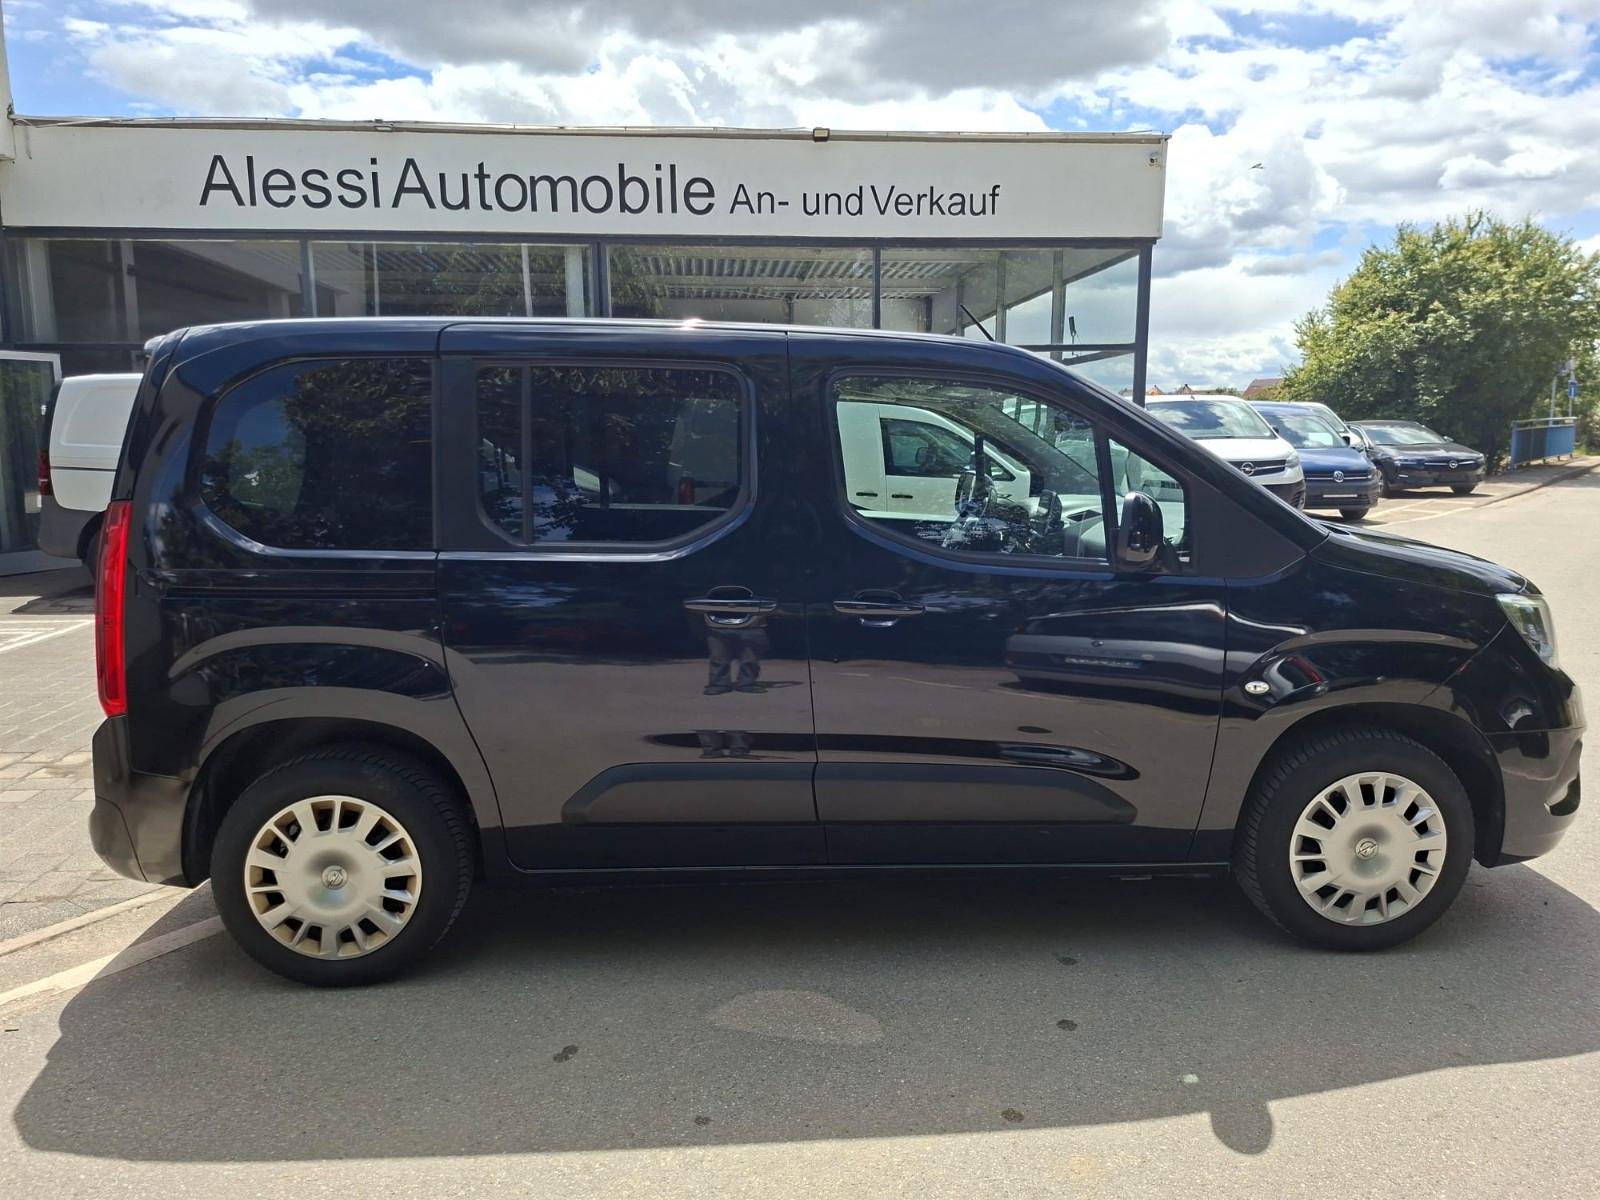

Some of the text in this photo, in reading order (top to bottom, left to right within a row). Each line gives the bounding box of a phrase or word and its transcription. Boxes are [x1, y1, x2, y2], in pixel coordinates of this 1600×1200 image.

[199, 154, 1001, 217] Alessi Automobile An- und Verkauf
